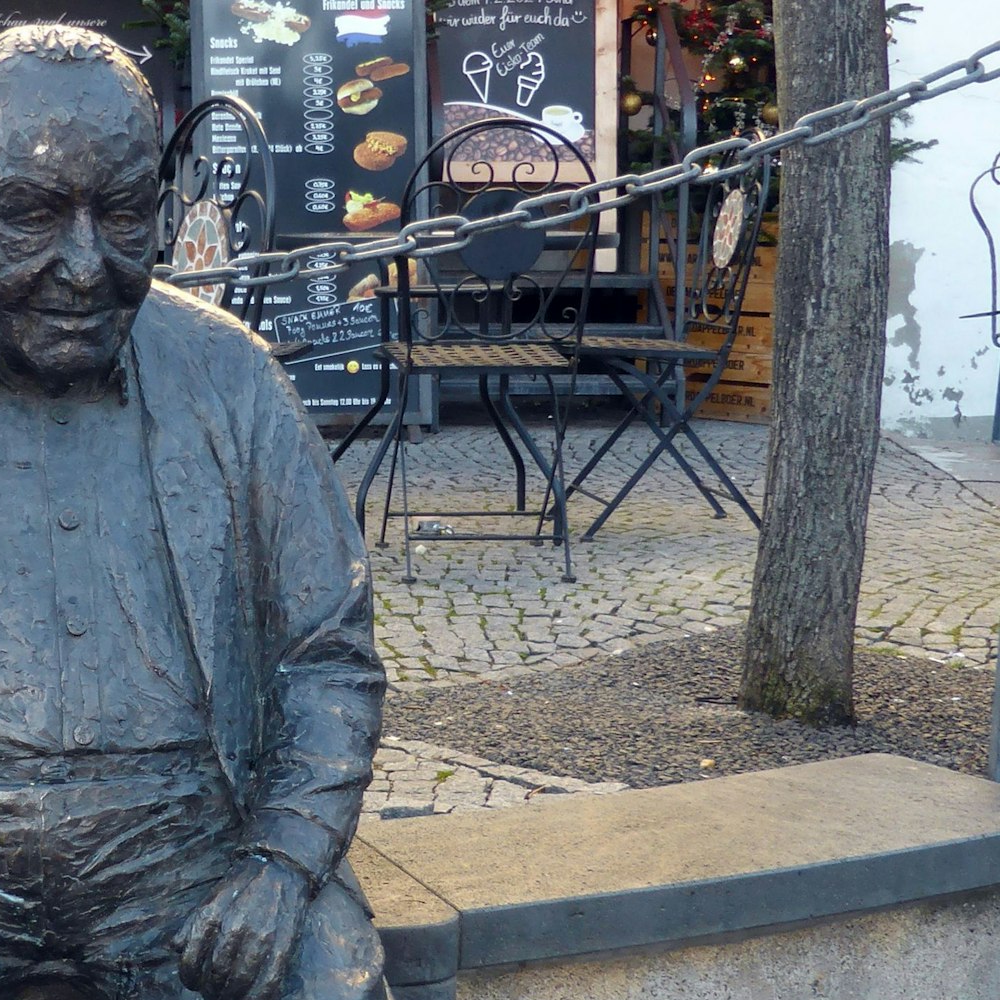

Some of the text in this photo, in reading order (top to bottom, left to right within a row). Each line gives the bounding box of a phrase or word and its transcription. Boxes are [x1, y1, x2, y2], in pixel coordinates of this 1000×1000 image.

[322, 0, 405, 11] Frikandel und Snacks
[67, 17, 108, 28] unsere
[499, 5, 522, 31] für
[524, 6, 552, 26] euch
[553, 7, 570, 27] da
[209, 37, 238, 49] Snacks
